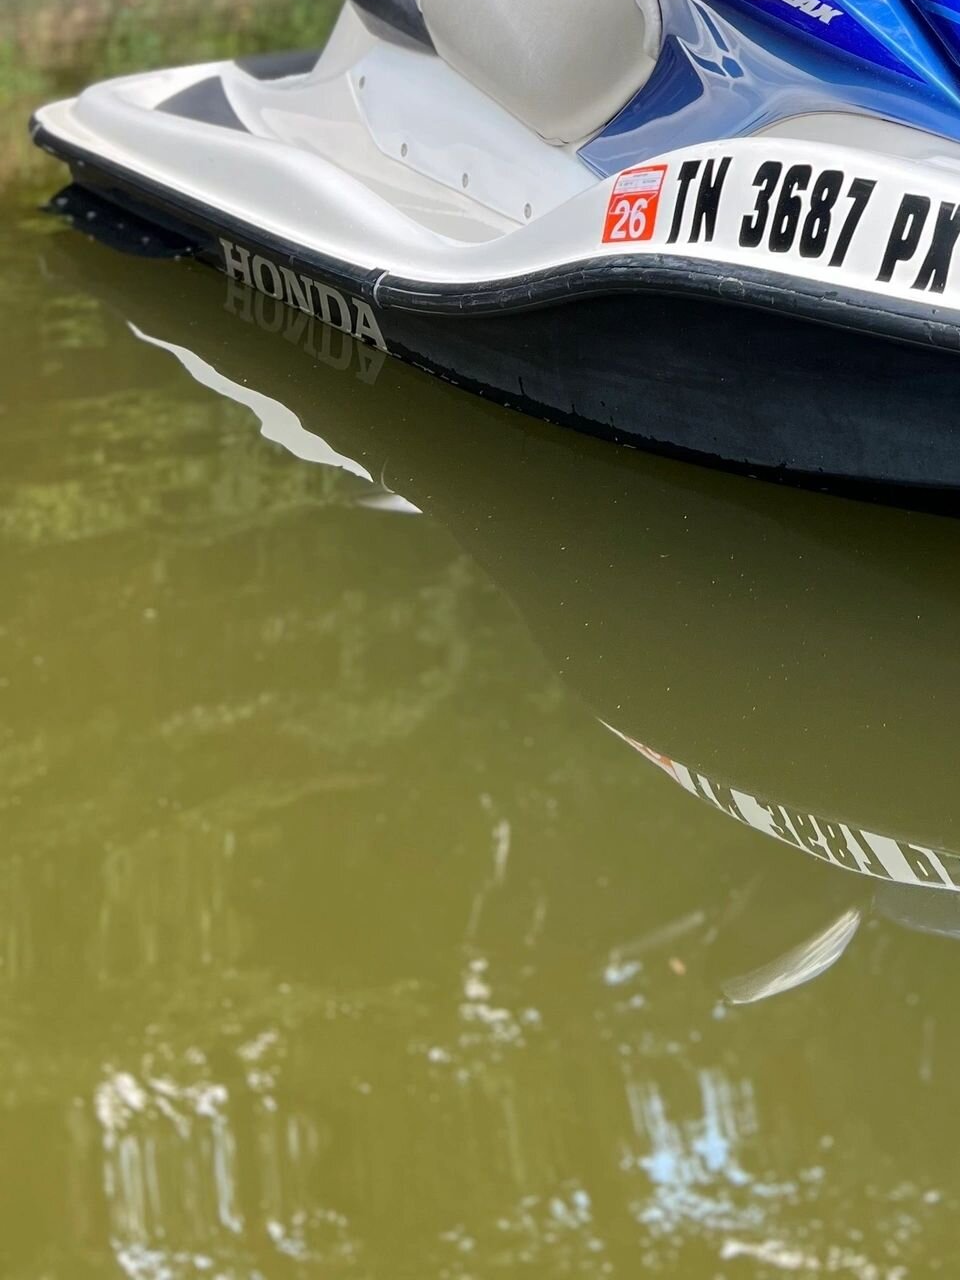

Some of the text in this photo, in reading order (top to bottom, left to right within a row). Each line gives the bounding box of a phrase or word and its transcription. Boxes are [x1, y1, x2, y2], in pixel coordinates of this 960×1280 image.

[610, 198, 648, 239] 26
[665, 157, 733, 244] TN
[738, 160, 877, 267] 3687
[219, 237, 389, 352] HONDA
